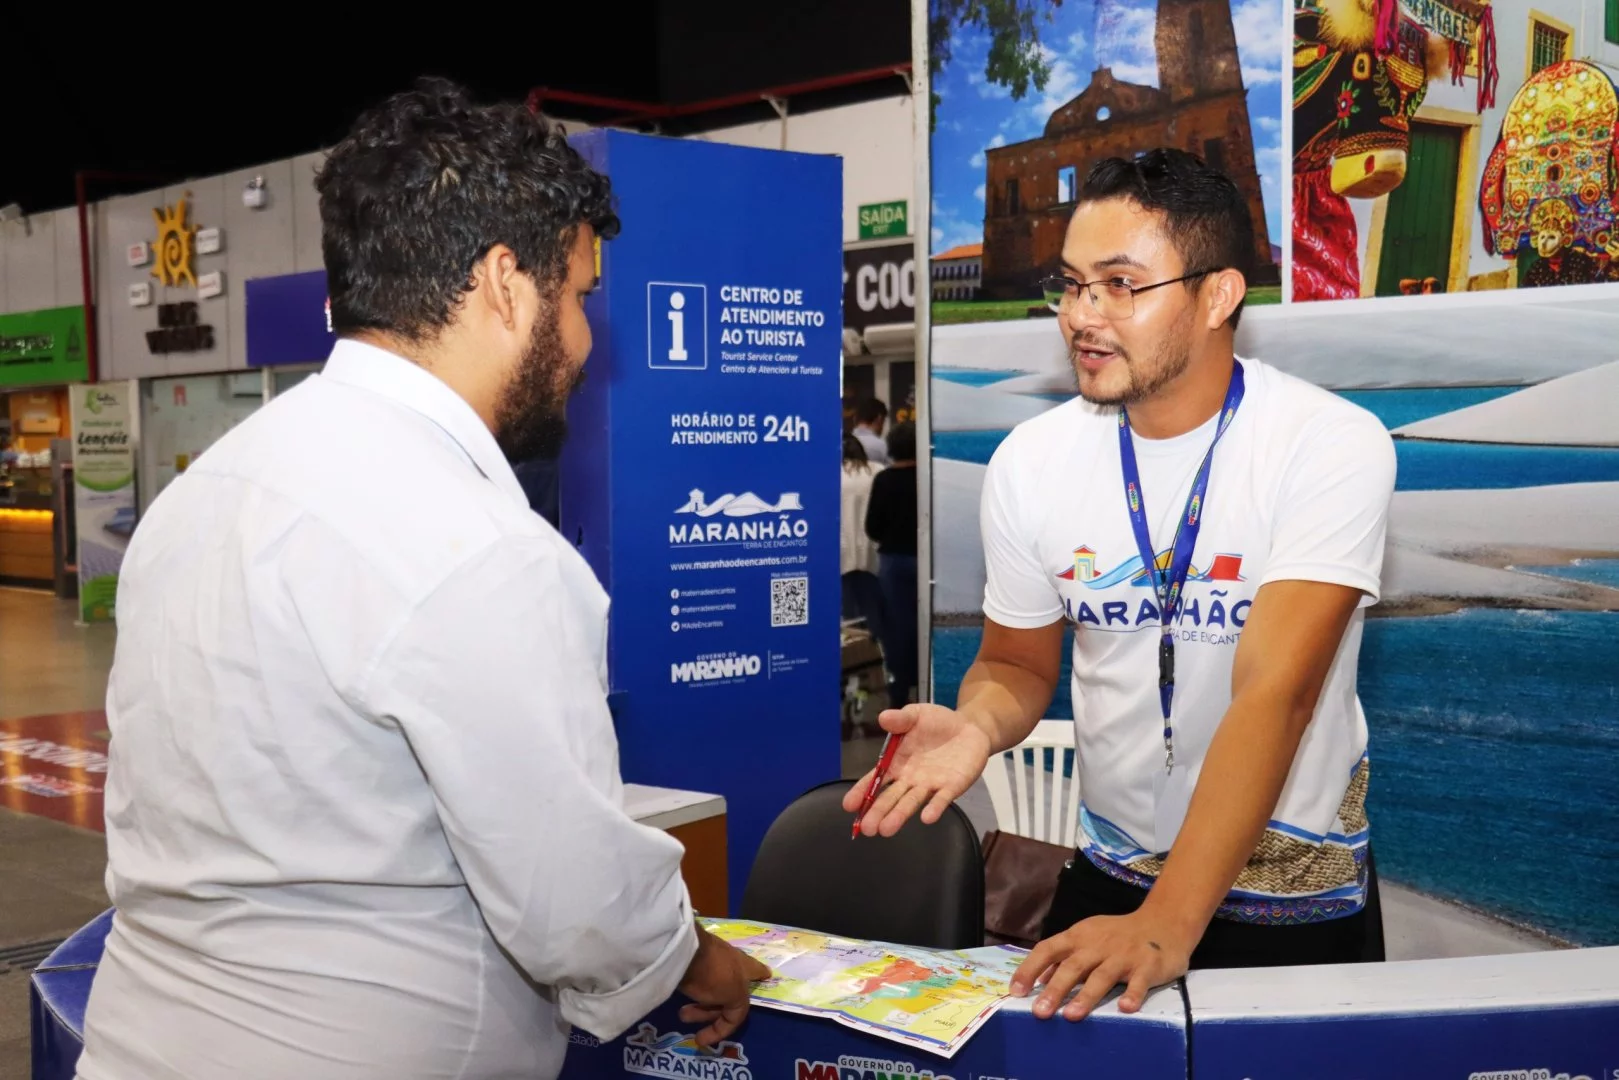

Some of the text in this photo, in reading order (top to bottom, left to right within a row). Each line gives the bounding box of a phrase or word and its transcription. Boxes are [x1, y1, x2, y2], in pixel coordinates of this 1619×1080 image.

[860, 204, 905, 226] SAÍDA
[720, 285, 803, 305] CENTRO DE
[720, 307, 825, 327] ATENDIMENTO
[720, 328, 805, 347] AO TURISTA
[721, 351, 798, 362] Tourist Service Center
[721, 364, 823, 375] Centro de Atención al Turista
[671, 411, 756, 427] HORÁRIO DE
[763, 415, 809, 442] 24h
[671, 431, 757, 444] ATENDIMENTO
[669, 514, 808, 543] MARANHÃO
[763, 541, 773, 549] DE
[773, 539, 808, 548] ENCANTOS
[670, 555, 808, 571] www.maranhaodeencantos.com.br
[1182, 630, 1198, 641] DE
[1200, 632, 1240, 645] ENCANT
[840, 1057, 892, 1071] GOVERNO
[897, 1063, 912, 1073] DO
